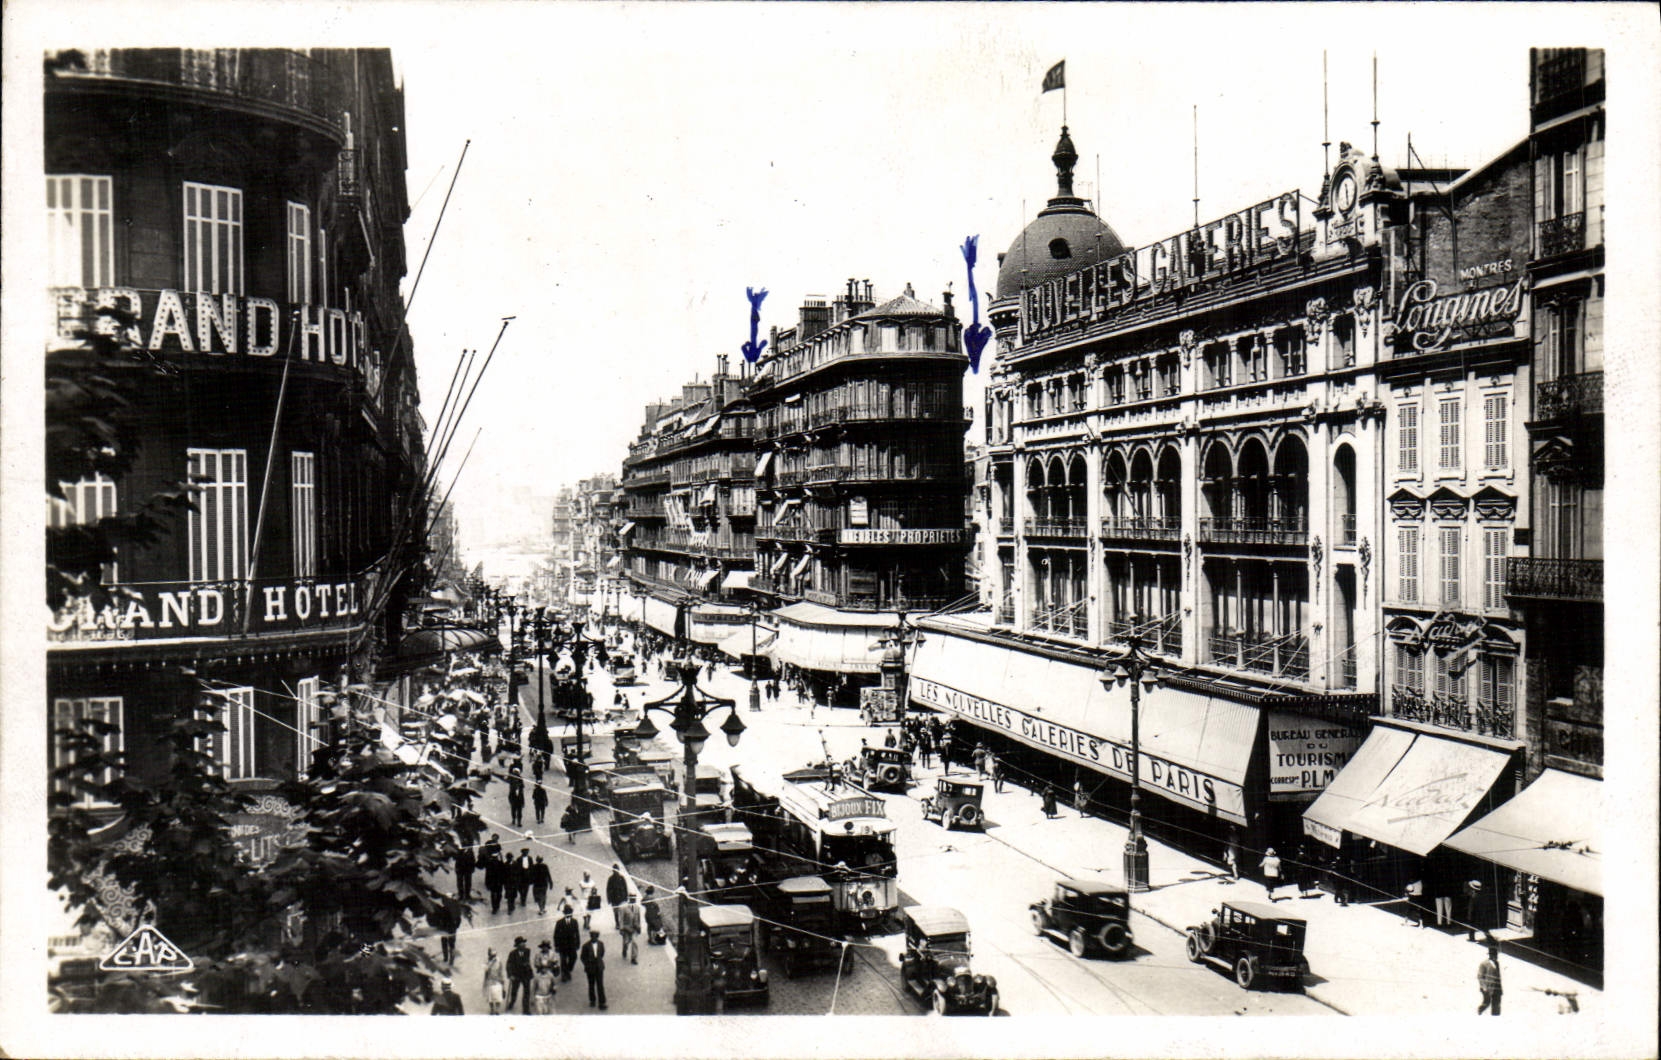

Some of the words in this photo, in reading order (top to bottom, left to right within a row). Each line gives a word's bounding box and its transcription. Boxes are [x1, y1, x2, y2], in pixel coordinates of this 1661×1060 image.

[1150, 193, 1297, 297] GALERIES
[1460, 259, 1512, 280] MONTRES
[1394, 279, 1524, 350] Longines
[301, 304, 364, 368] HOT
[919, 681, 939, 702] LES
[945, 690, 1012, 730] NOUVELLES
[1021, 716, 1099, 762] GALERIES
[1113, 749, 1135, 774] DE
[1152, 760, 1217, 803] PARIS
[1271, 729, 1310, 740] BUREAU
[1277, 752, 1351, 767] TOURISM
[831, 803, 861, 817] BIJOUX
[865, 801, 884, 815] FIX
